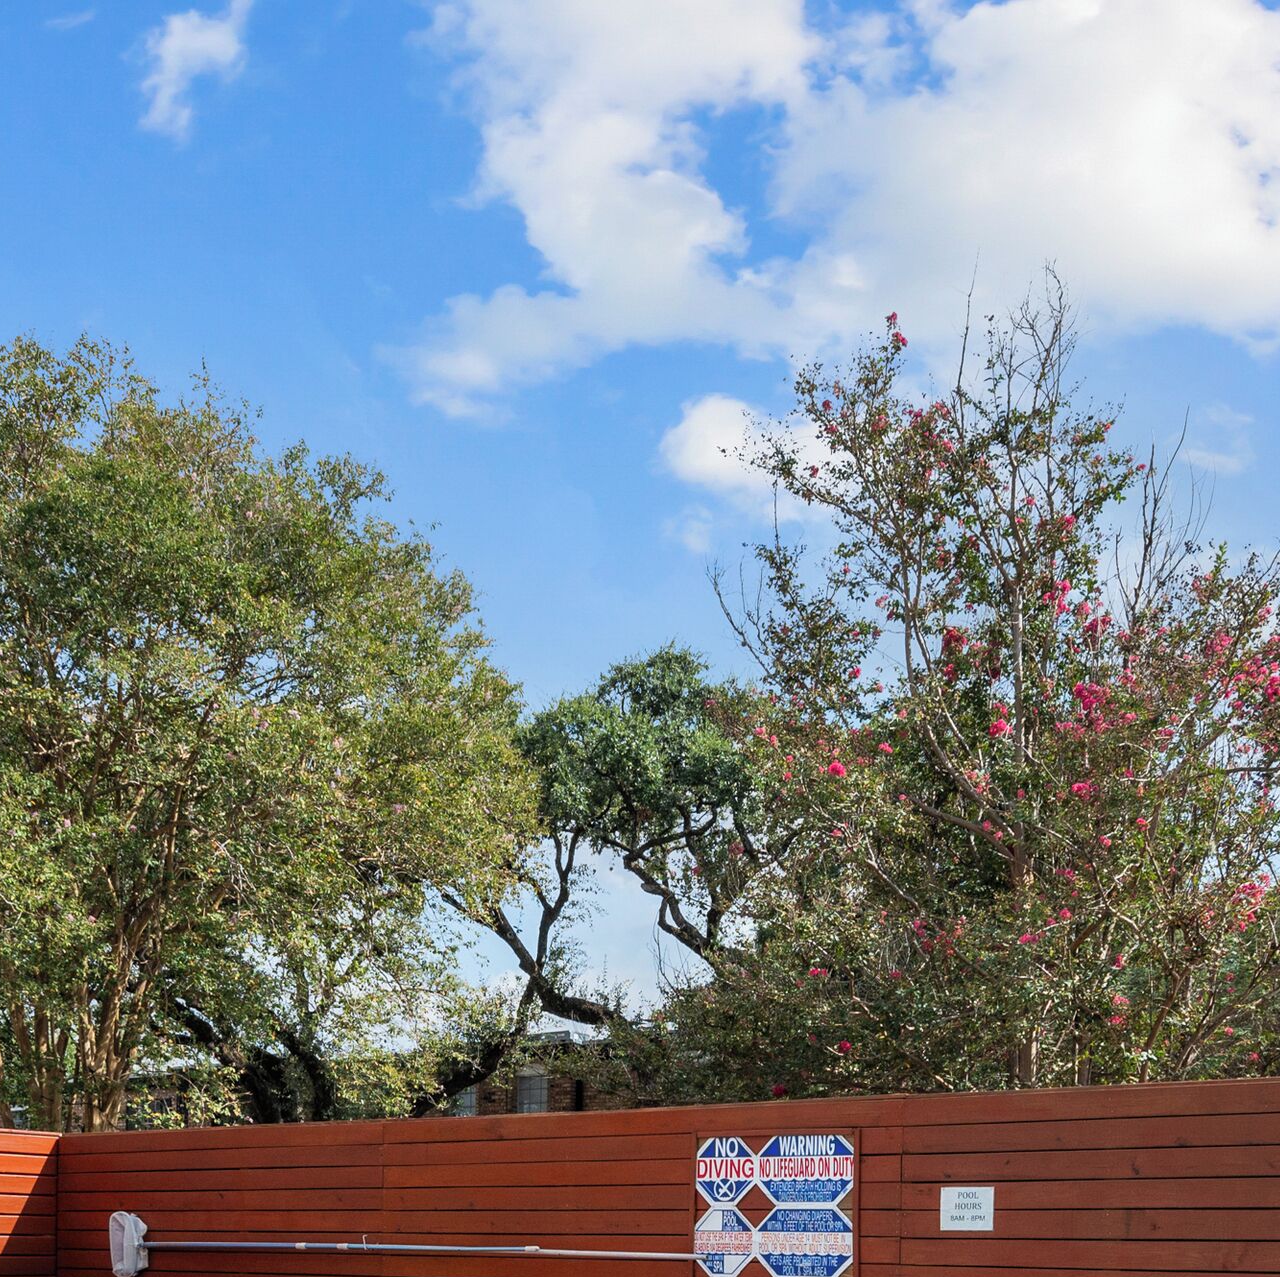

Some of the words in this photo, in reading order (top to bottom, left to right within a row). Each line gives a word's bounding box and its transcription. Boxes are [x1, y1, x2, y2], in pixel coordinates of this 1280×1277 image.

[715, 1136, 739, 1158] NO
[779, 1135, 836, 1156] WARNING
[697, 1159, 754, 1179] DIVING
[760, 1157, 771, 1178] NO
[773, 1157, 816, 1178] LIFEGUARD
[818, 1157, 830, 1178] ON
[833, 1157, 855, 1178] DUTY
[770, 1181, 795, 1192] EXTENDED
[796, 1181, 814, 1192] BREATH
[815, 1181, 836, 1192] HOLDING
[837, 1181, 842, 1192] IS
[957, 1192, 979, 1200] POOL
[724, 1215, 738, 1227] POOL
[777, 1211, 785, 1221] NO
[786, 1211, 811, 1221] CHANGING
[812, 1211, 834, 1221] DIAPERS
[767, 1221, 782, 1231] WITHIN
[788, 1221, 798, 1231] FEET
[798, 1221, 805, 1231] OF
[805, 1221, 815, 1231] THE
[815, 1221, 827, 1231] POOL
[827, 1221, 834, 1231] OR
[835, 1221, 844, 1231] SPA
[770, 1255, 782, 1265] PETS
[783, 1255, 793, 1265] ARE
[822, 1256, 827, 1266] IN
[828, 1256, 838, 1266] THE
[713, 1261, 724, 1273] SPA
[783, 1266, 795, 1276] POOL
[803, 1266, 813, 1276] SPA
[814, 1266, 827, 1276] AREA
